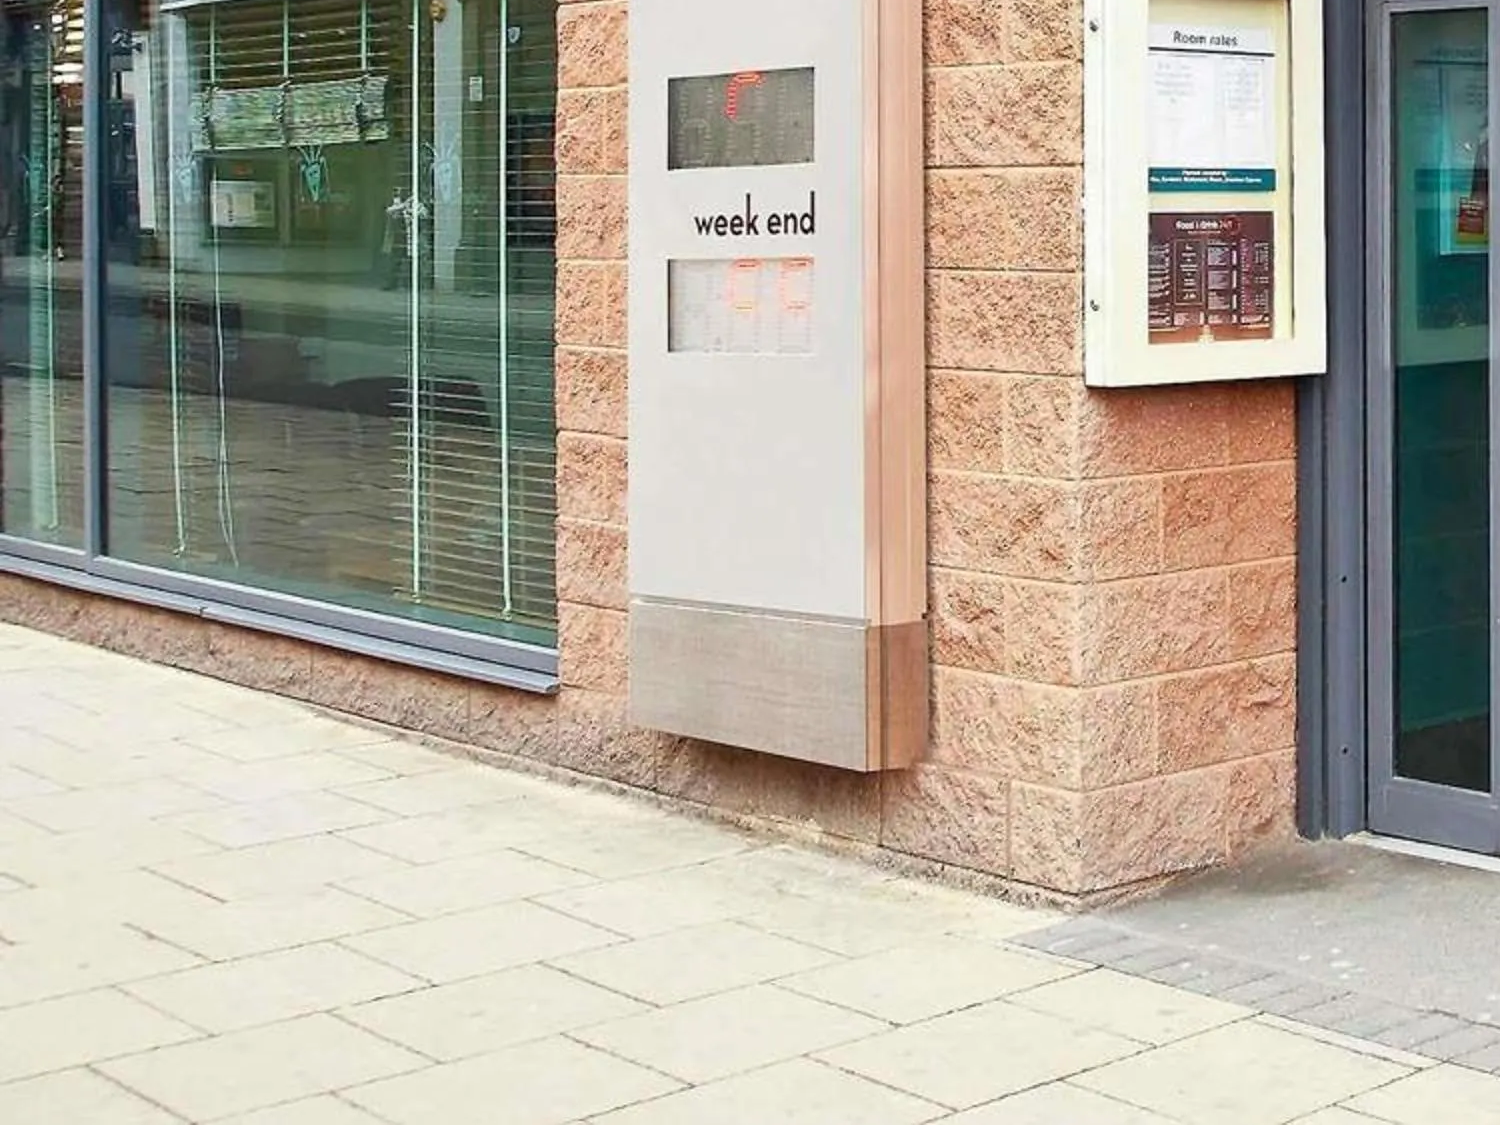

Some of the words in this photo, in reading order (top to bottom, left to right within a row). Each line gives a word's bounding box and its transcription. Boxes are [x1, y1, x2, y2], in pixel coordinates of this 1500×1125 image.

[1173, 30, 1207, 44] Room
[1209, 34, 1239, 46] rates
[694, 193, 760, 237] week
[767, 191, 816, 235] end
